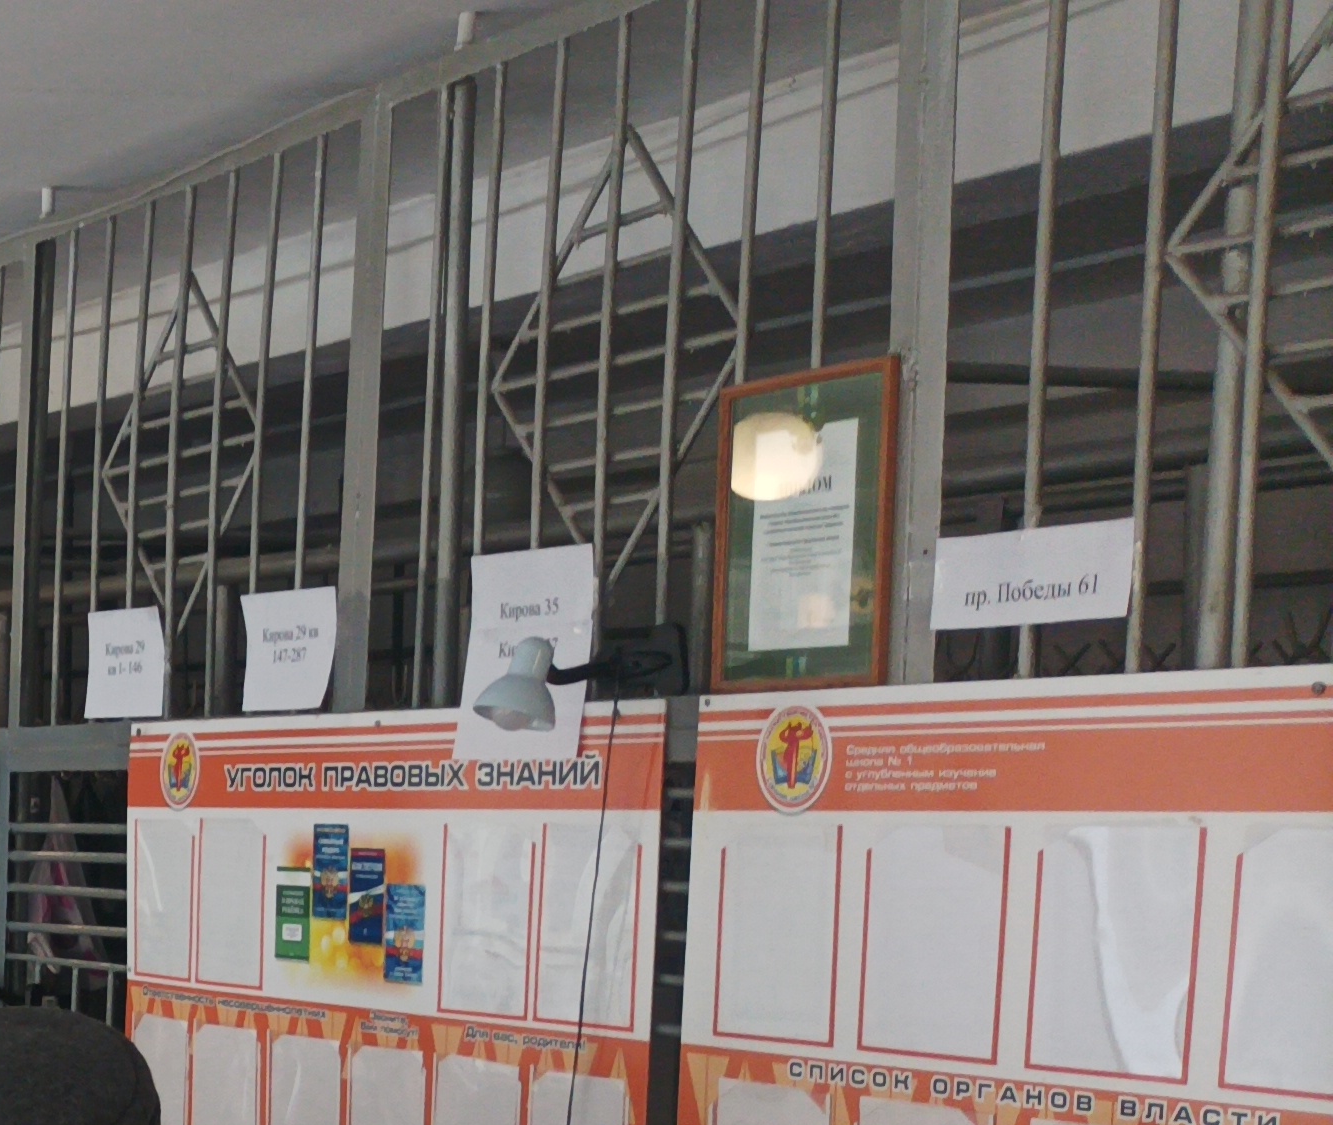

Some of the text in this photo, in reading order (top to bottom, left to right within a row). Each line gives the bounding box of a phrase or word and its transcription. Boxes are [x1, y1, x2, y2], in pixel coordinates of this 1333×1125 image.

[964, 573, 1098, 611] пр. Победы 61
[500, 597, 559, 621] Кирова 35
[262, 627, 293, 645] Кирова
[295, 624, 307, 641] 29
[105, 642, 133, 658] Кирова
[226, 754, 600, 789] УГОЛОК ПРАВОВЫХ ЗНАНИЙ
[465, 1025, 488, 1039] Для
[789, 1061, 910, 1091] СПИСОК
[932, 1077, 1092, 1113] ОРГАНОВ
